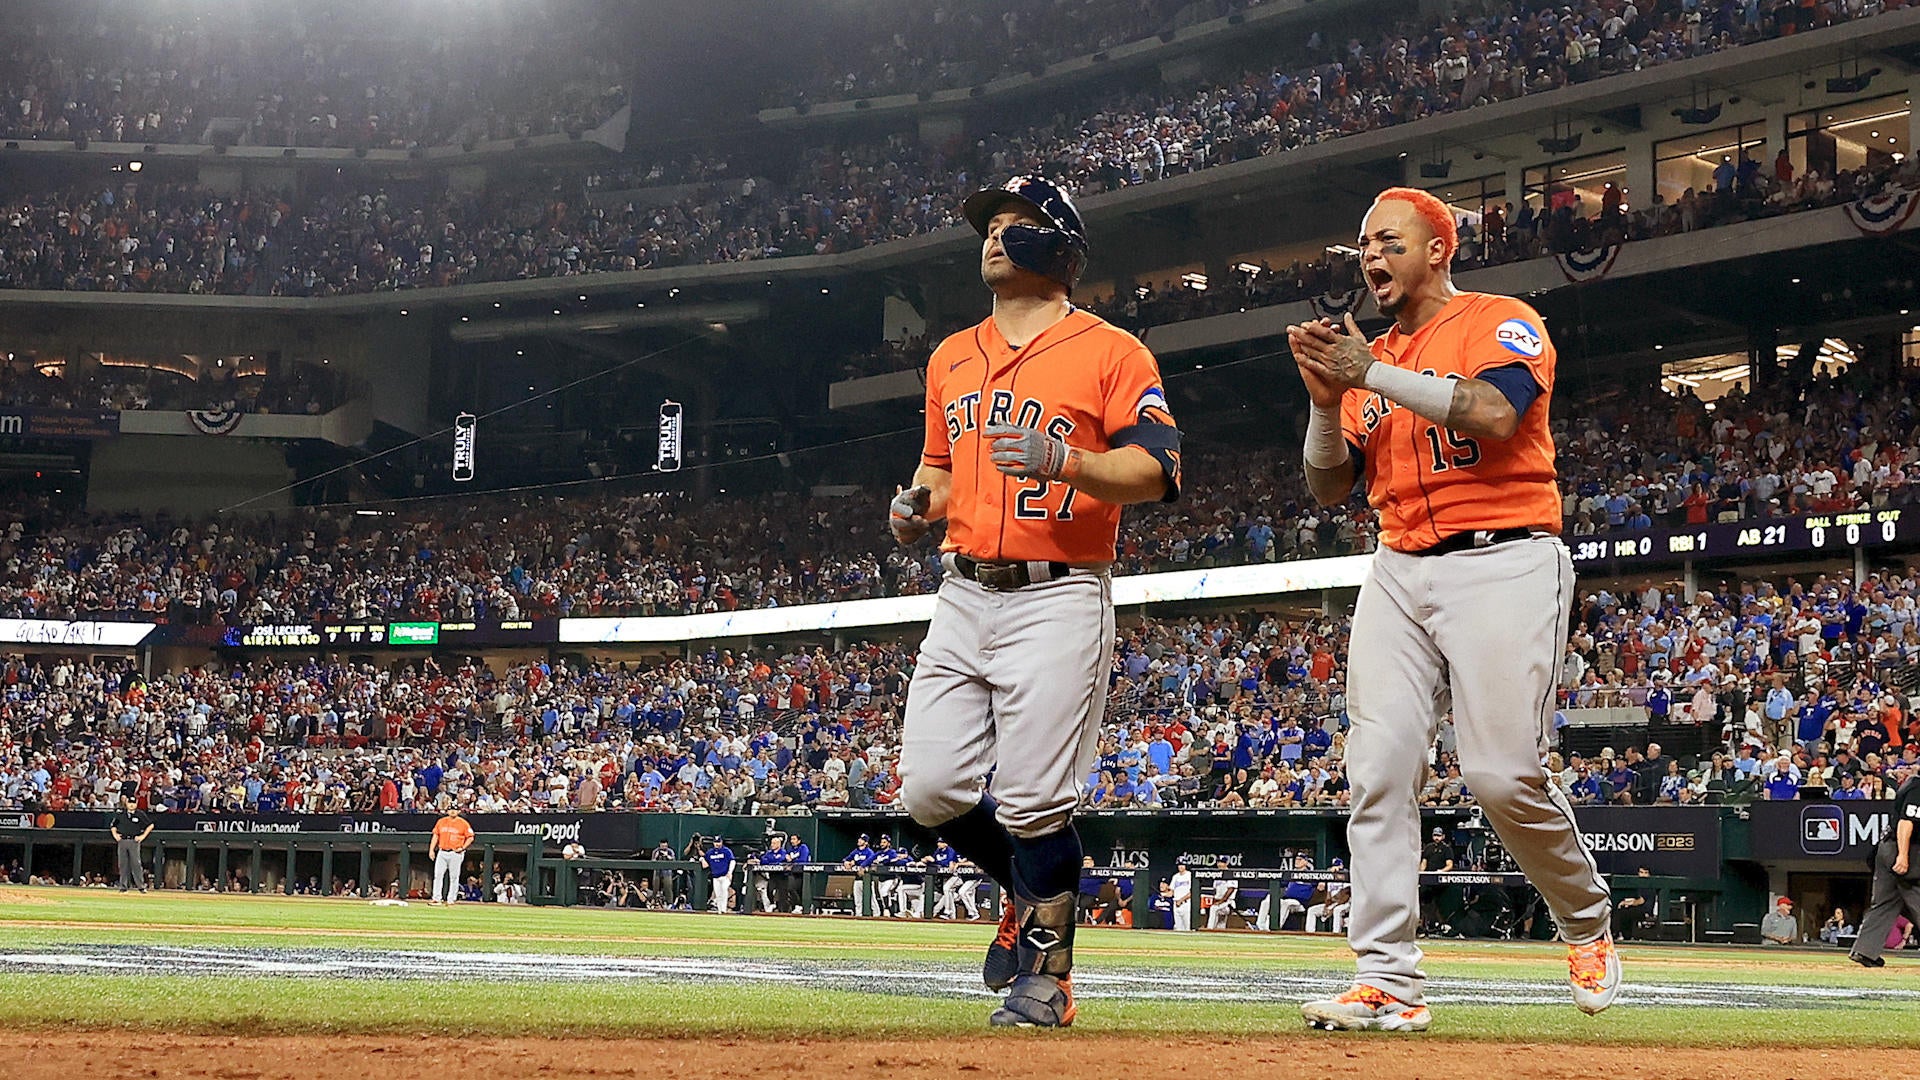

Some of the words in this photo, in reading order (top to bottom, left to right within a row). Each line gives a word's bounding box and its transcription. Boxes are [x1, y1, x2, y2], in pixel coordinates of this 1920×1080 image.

[1498, 330, 1540, 348] OXY
[945, 389, 1076, 445] STROS
[454, 425, 467, 470] TRULY
[660, 414, 672, 462] TRULY
[1425, 425, 1482, 474] 15
[1015, 475, 1078, 521] 27
[1806, 516, 1831, 529] BALL
[1835, 512, 1871, 526] STRIKE
[1877, 510, 1901, 522] OUT
[1572, 540, 1608, 561] .381
[1614, 540, 1637, 557] HR
[1639, 536, 1651, 555] 0
[1669, 535, 1694, 552] RBI
[1697, 532, 1708, 550] 1
[1737, 528, 1761, 546] AB
[1763, 525, 1786, 545] 21
[1811, 526, 1825, 547] 0
[1846, 524, 1860, 544] 0
[1882, 520, 1896, 541] 0
[251, 624, 274, 636] JOSÉ
[274, 625, 313, 636] LECLERC
[329, 632, 337, 643] 9
[350, 631, 361, 642] 11
[370, 631, 383, 642] 20
[217, 820, 245, 832] ALCS
[354, 821, 380, 833] MLB
[514, 820, 581, 844] loanDepot
[1581, 833, 1655, 852] SEASON
[1656, 836, 1695, 848] 2023
[1110, 850, 1149, 868] ALCS
[1447, 875, 1490, 884] POSTSEASON
